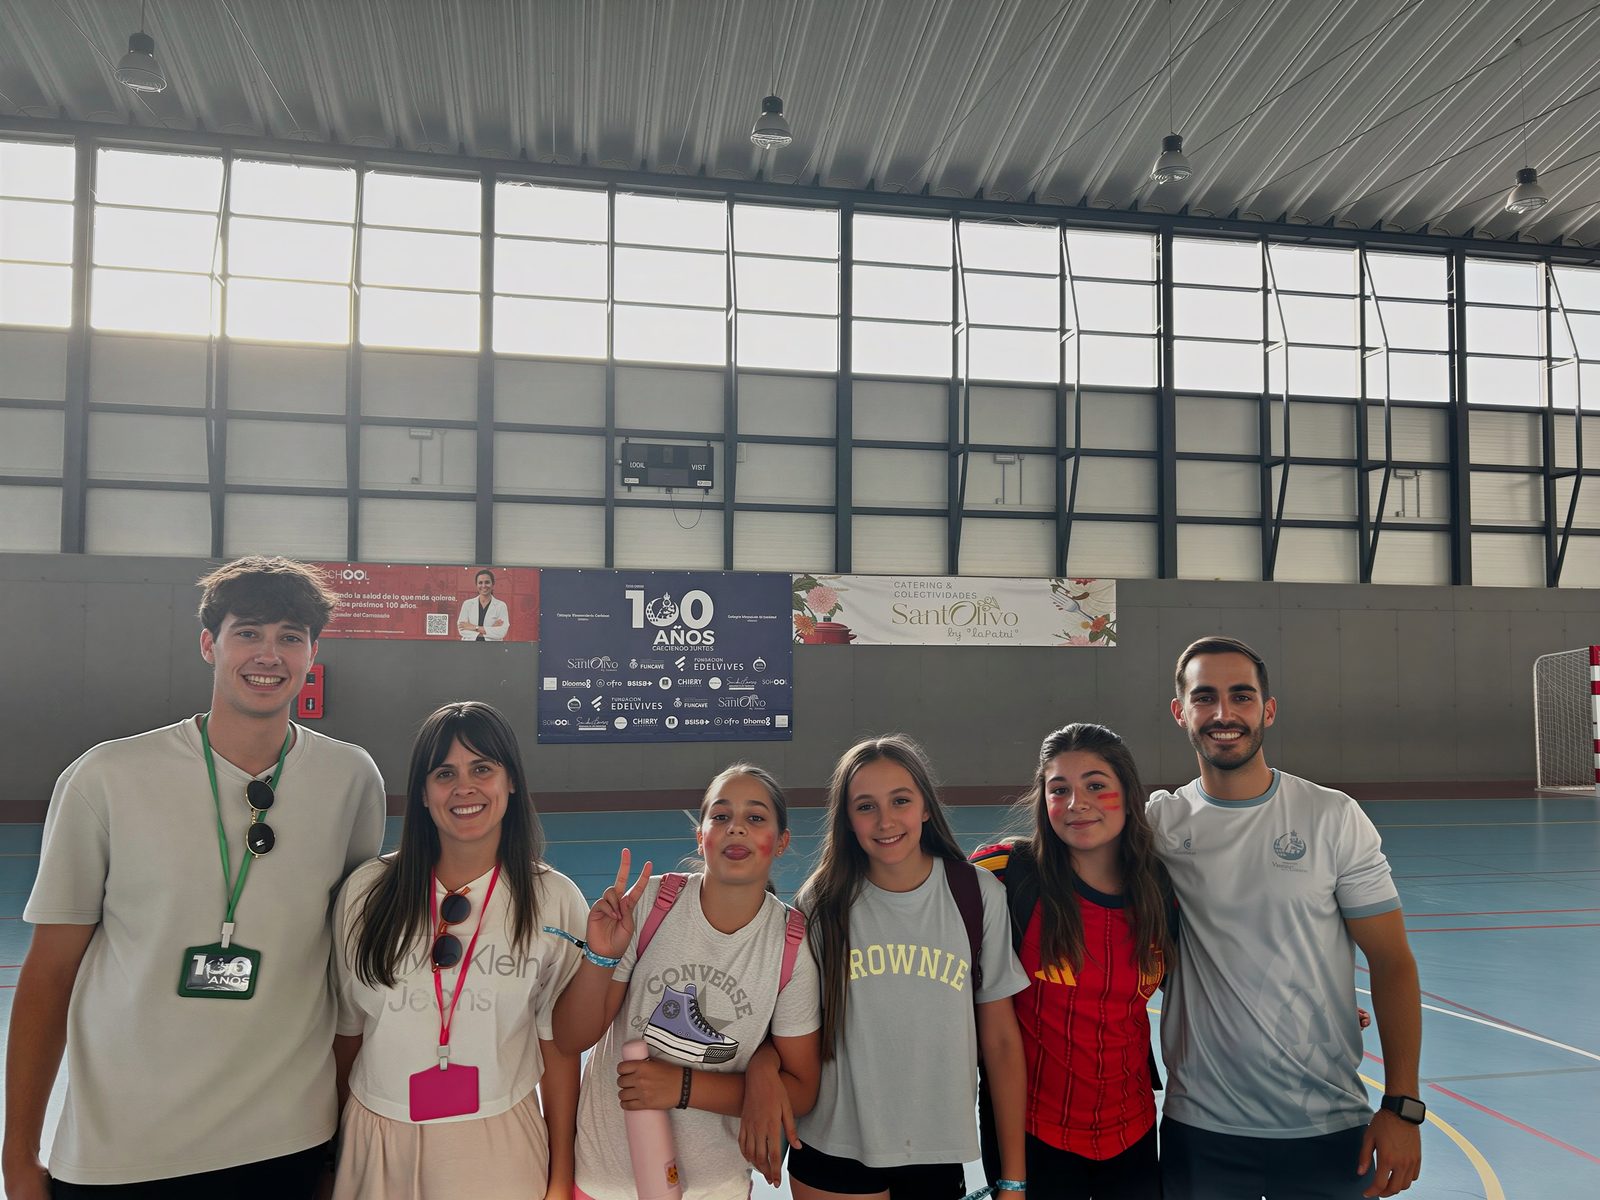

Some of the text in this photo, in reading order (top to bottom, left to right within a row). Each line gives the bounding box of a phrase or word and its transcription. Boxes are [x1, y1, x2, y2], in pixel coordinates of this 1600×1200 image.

[893, 581, 953, 590] CATERING &
[894, 591, 977, 600] COLECTIVIDADES
[891, 600, 1019, 627] SantOlivo
[653, 625, 716, 646] AÑOS
[947, 627, 962, 642] by
[693, 663, 745, 671] EDELVIVES
[611, 702, 664, 711] EDELVIVES
[632, 717, 659, 726] CHIRRY
[471, 944, 542, 980] Klein
[850, 943, 969, 992] ROWNIE
[388, 978, 493, 1013] Jeans
[646, 963, 753, 1021] CONVERSE
